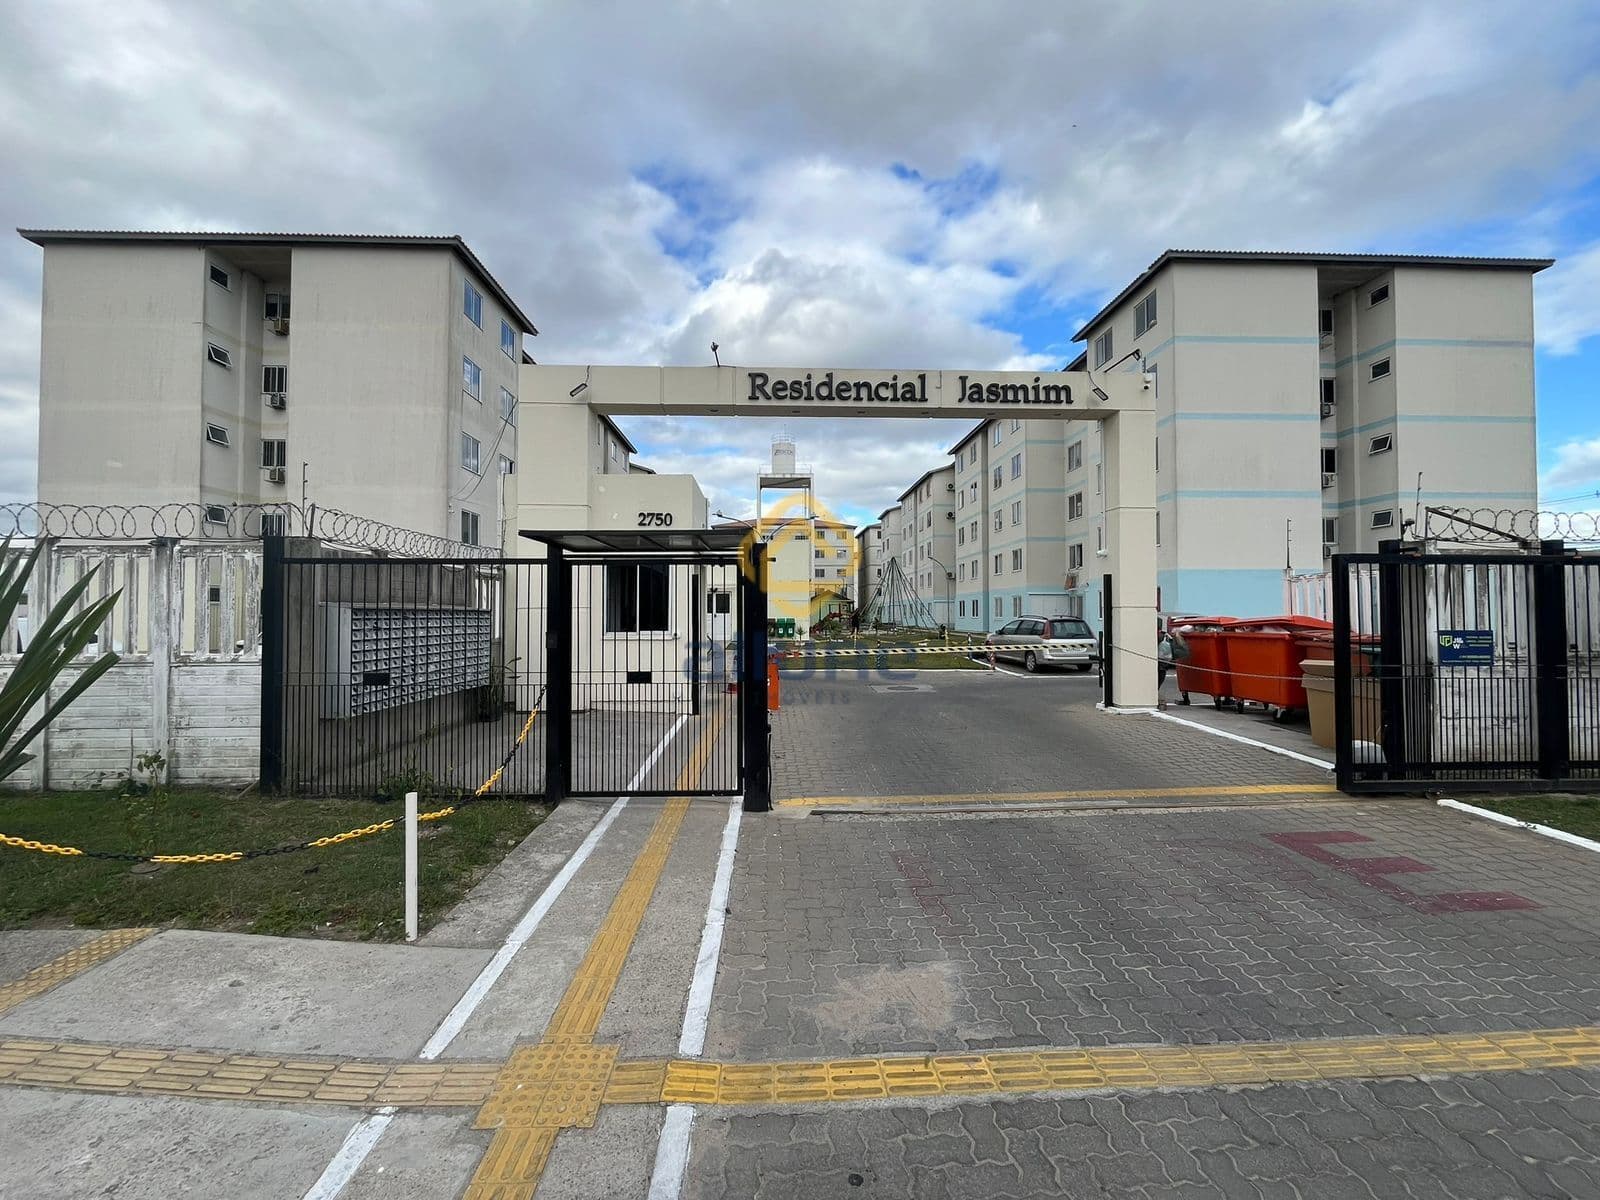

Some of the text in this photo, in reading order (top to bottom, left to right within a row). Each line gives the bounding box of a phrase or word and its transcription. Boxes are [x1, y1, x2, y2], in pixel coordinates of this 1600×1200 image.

[748, 372, 1073, 403] Residencial Jasmim
[637, 512, 673, 527] 2750
